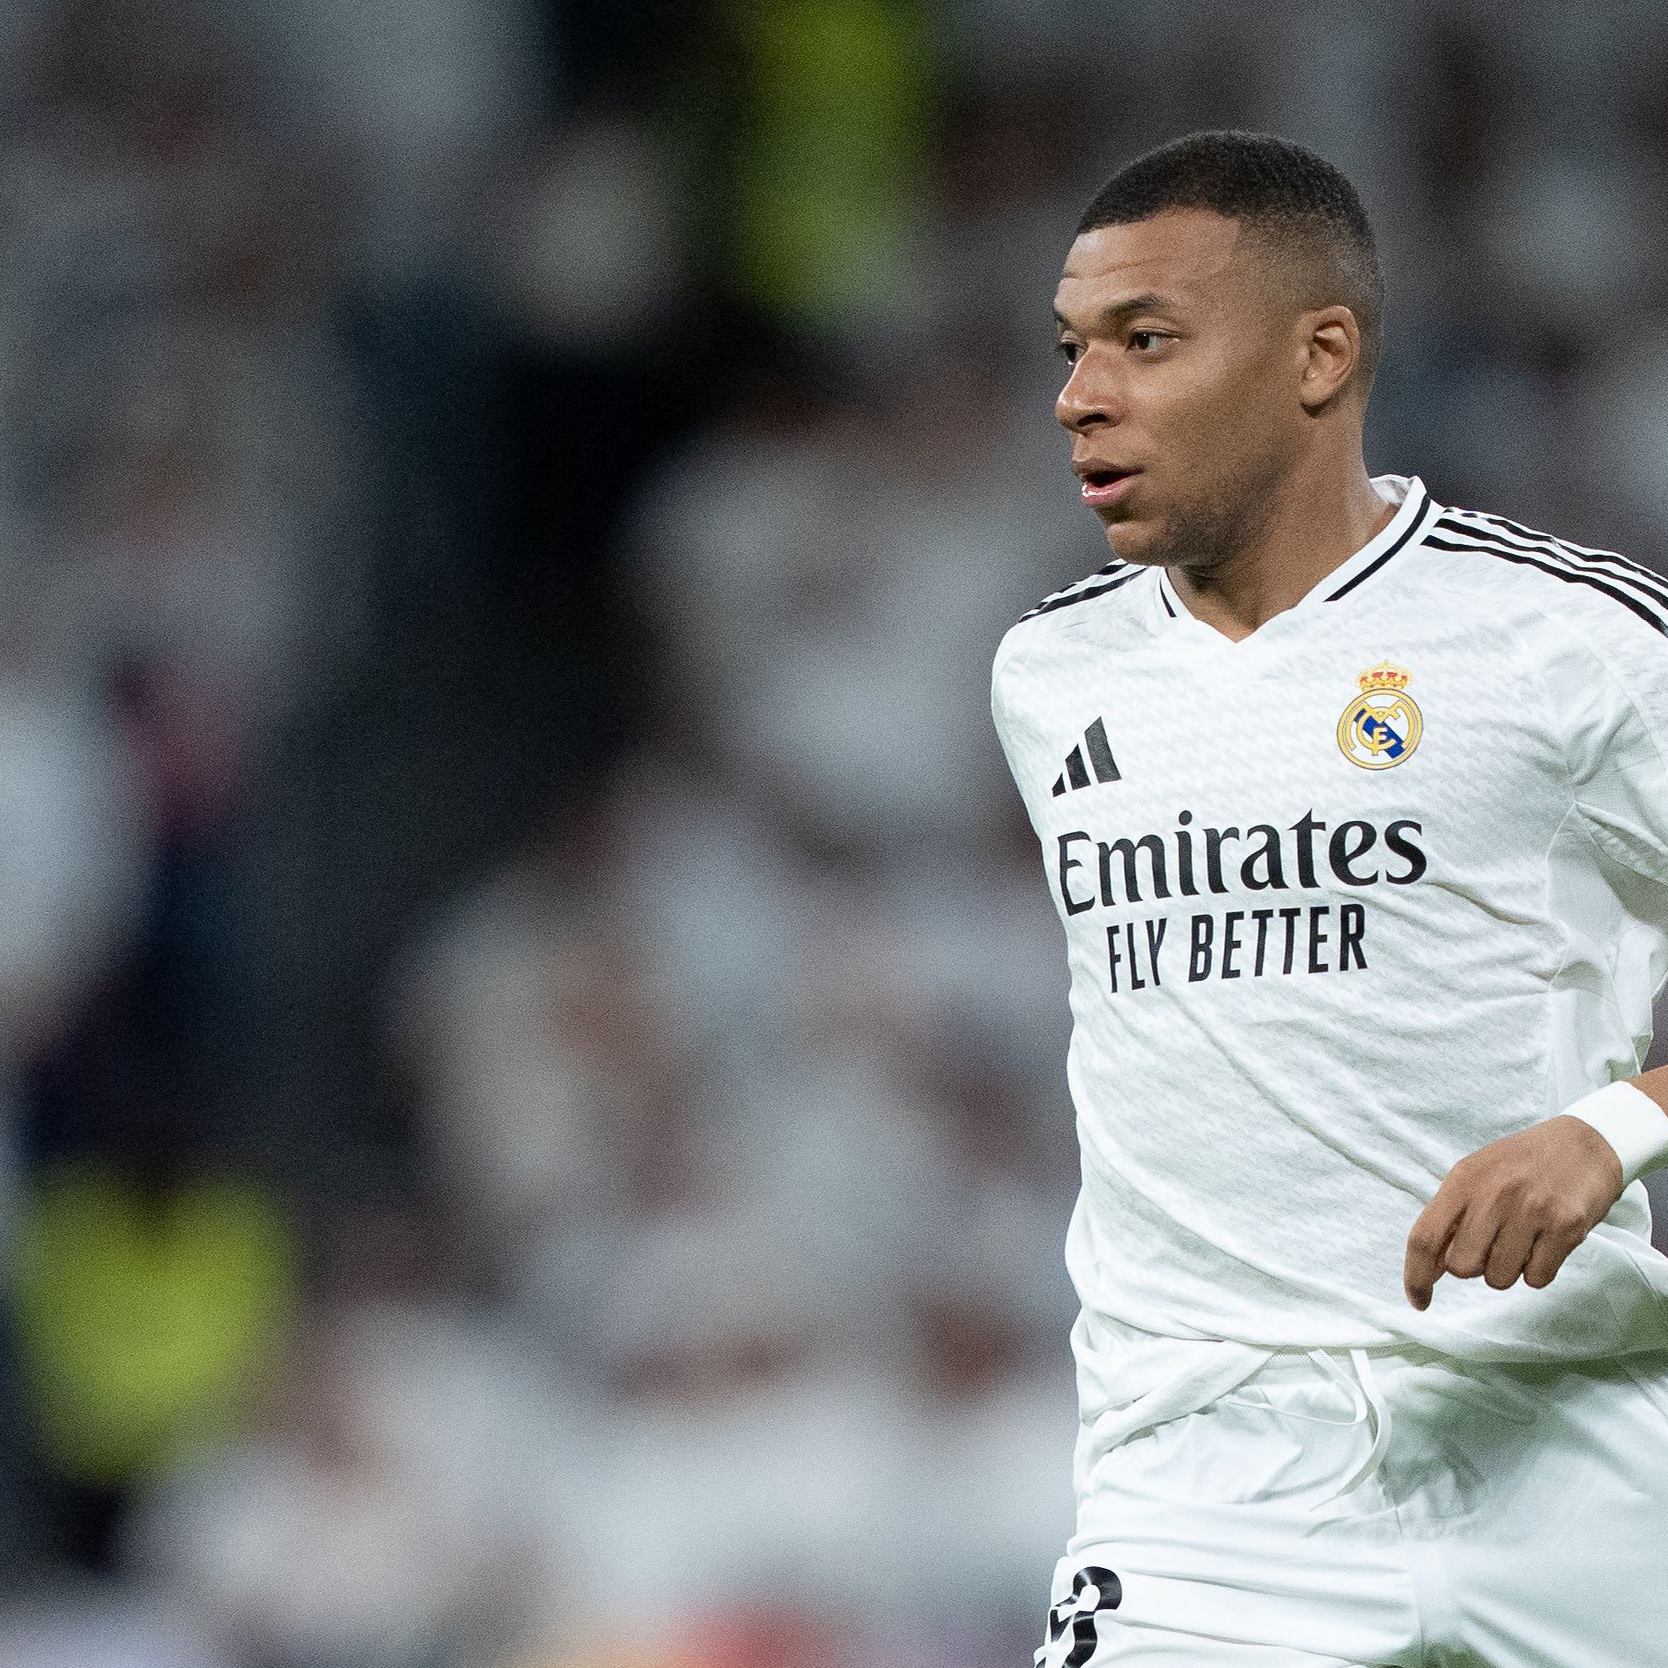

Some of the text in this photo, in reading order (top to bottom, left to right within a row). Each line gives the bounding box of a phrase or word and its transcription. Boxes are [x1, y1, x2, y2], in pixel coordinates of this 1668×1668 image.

[1057, 808, 1428, 916] Emirates
[1106, 903, 1369, 993] FLY BETTER
